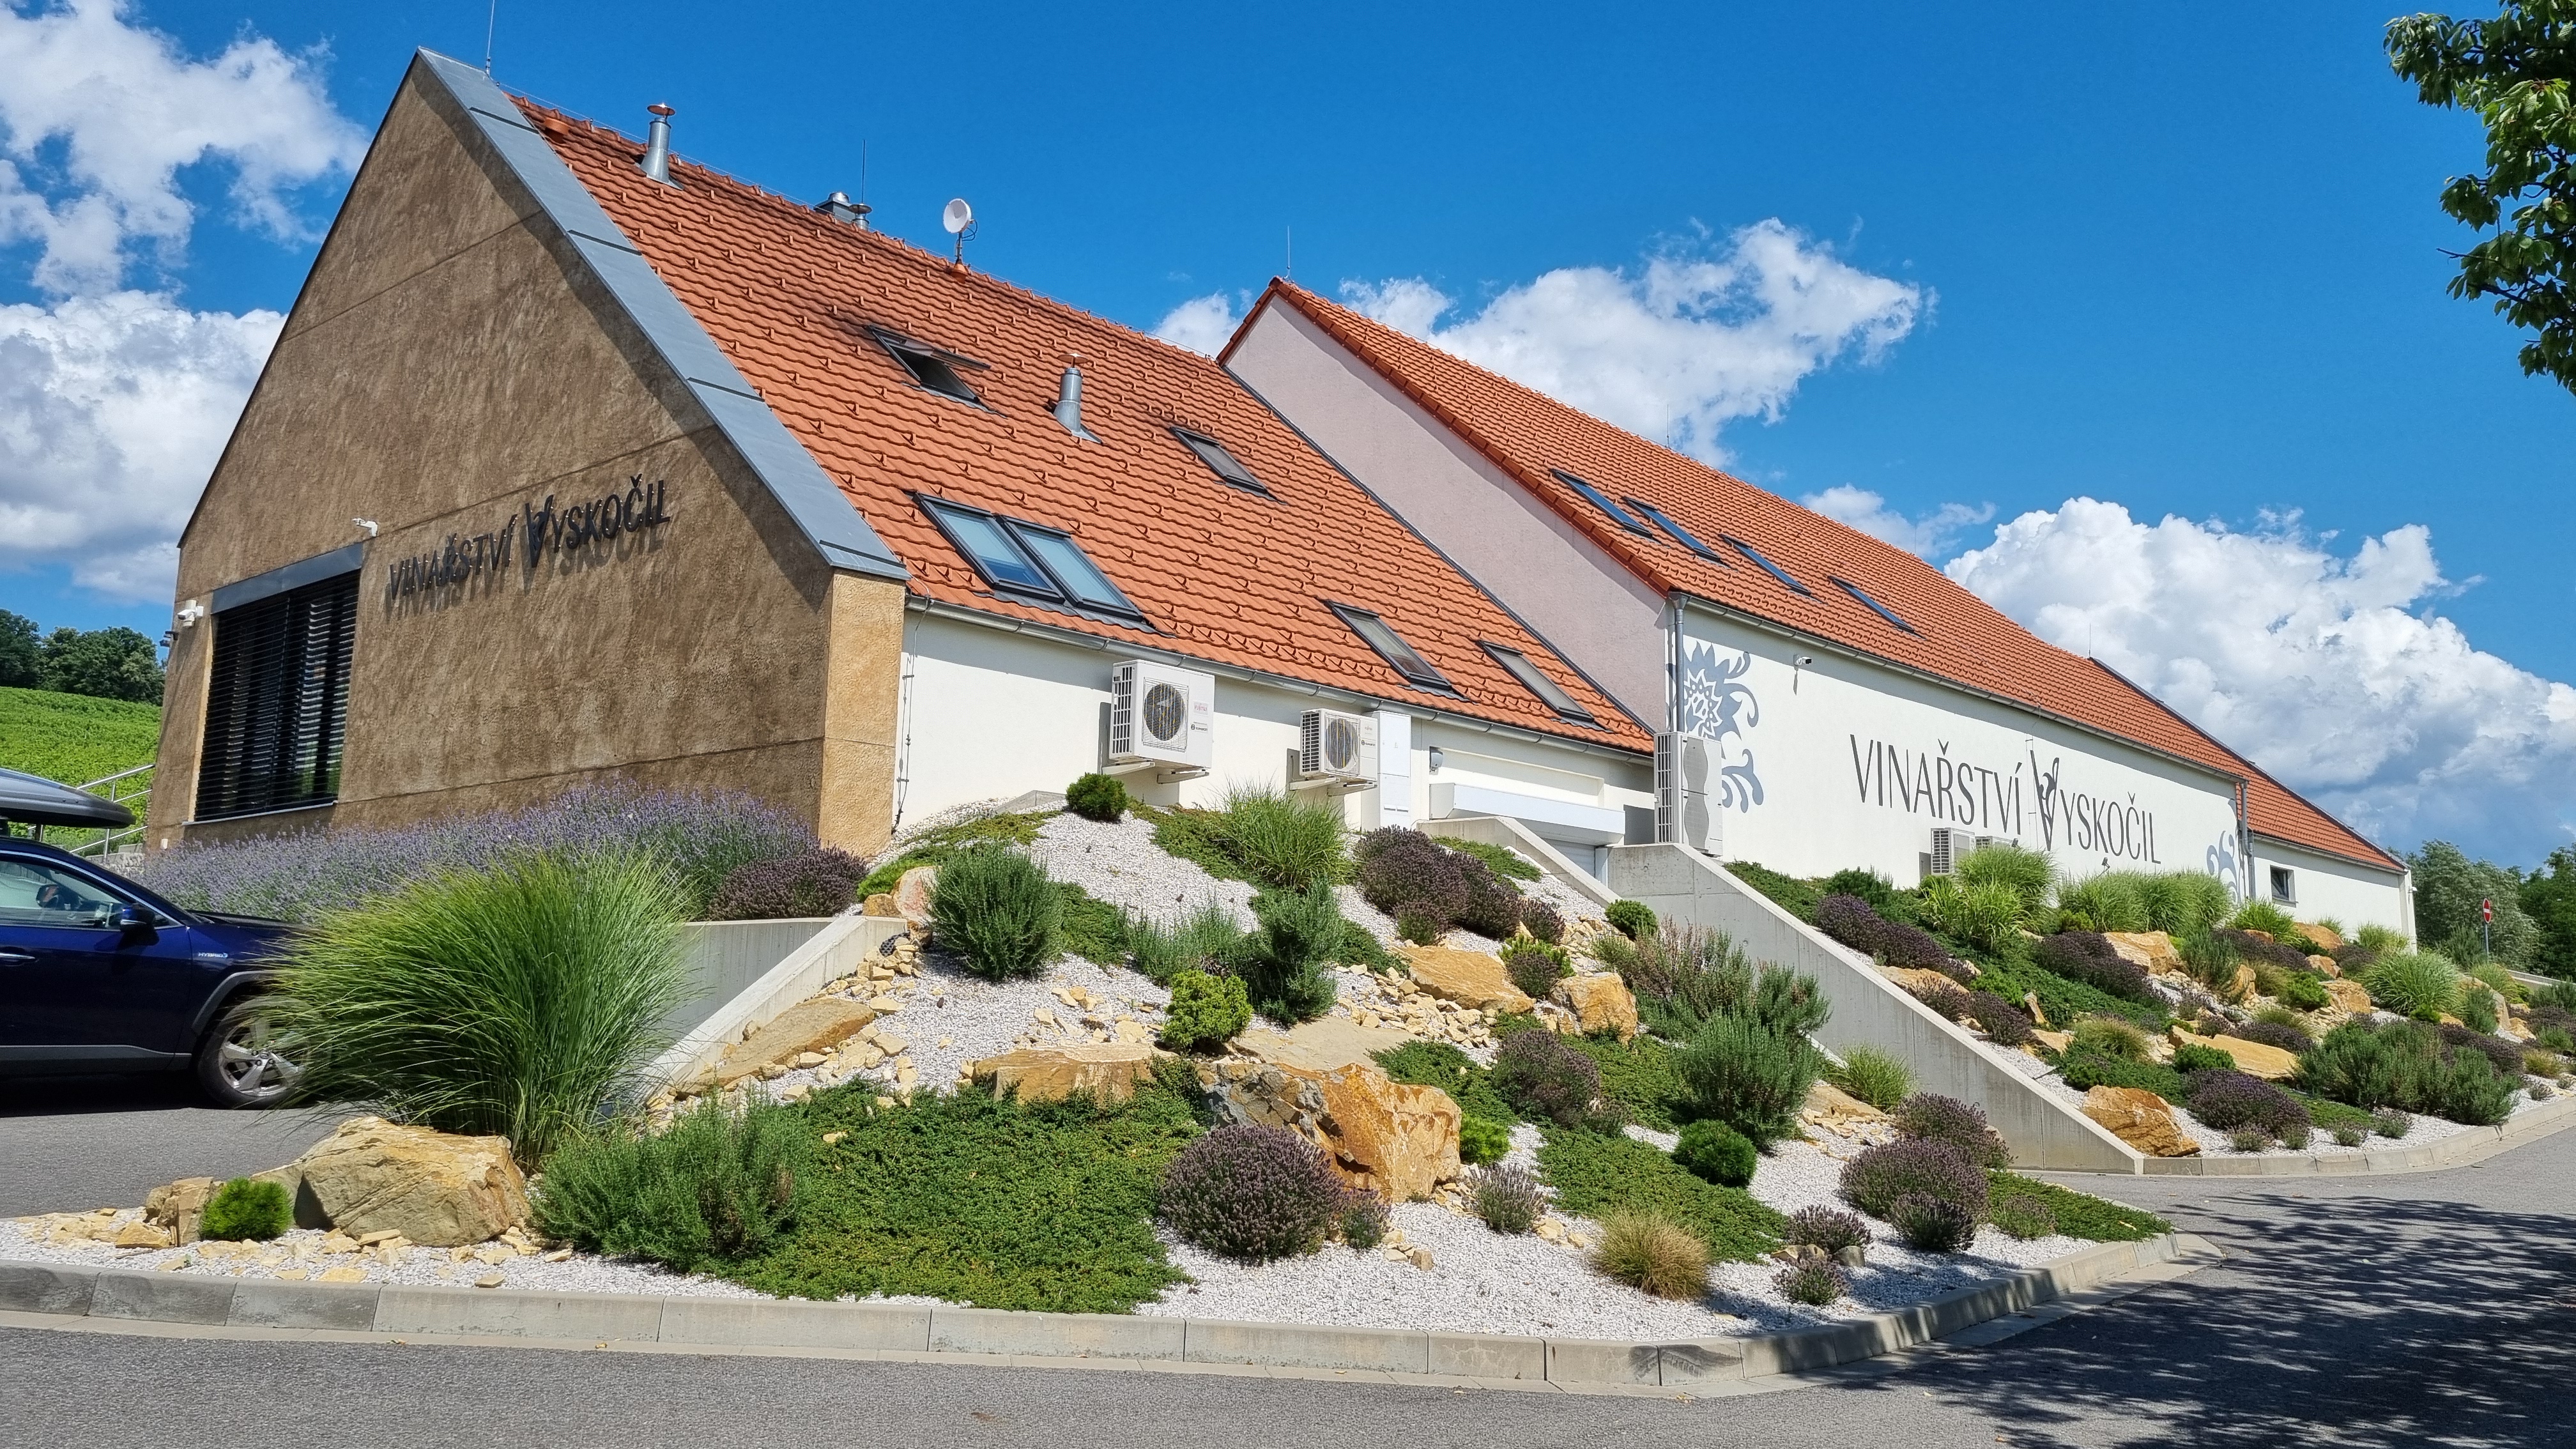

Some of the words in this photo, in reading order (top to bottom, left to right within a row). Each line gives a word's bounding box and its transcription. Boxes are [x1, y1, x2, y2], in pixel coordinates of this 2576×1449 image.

[390, 514, 518, 599] VINAŘSTVÍ
[525, 473, 670, 568] VYSKOČIL
[1850, 734, 2022, 835] VINAŘSTVÍ
[2030, 749, 2161, 864] VYSKOČIL
